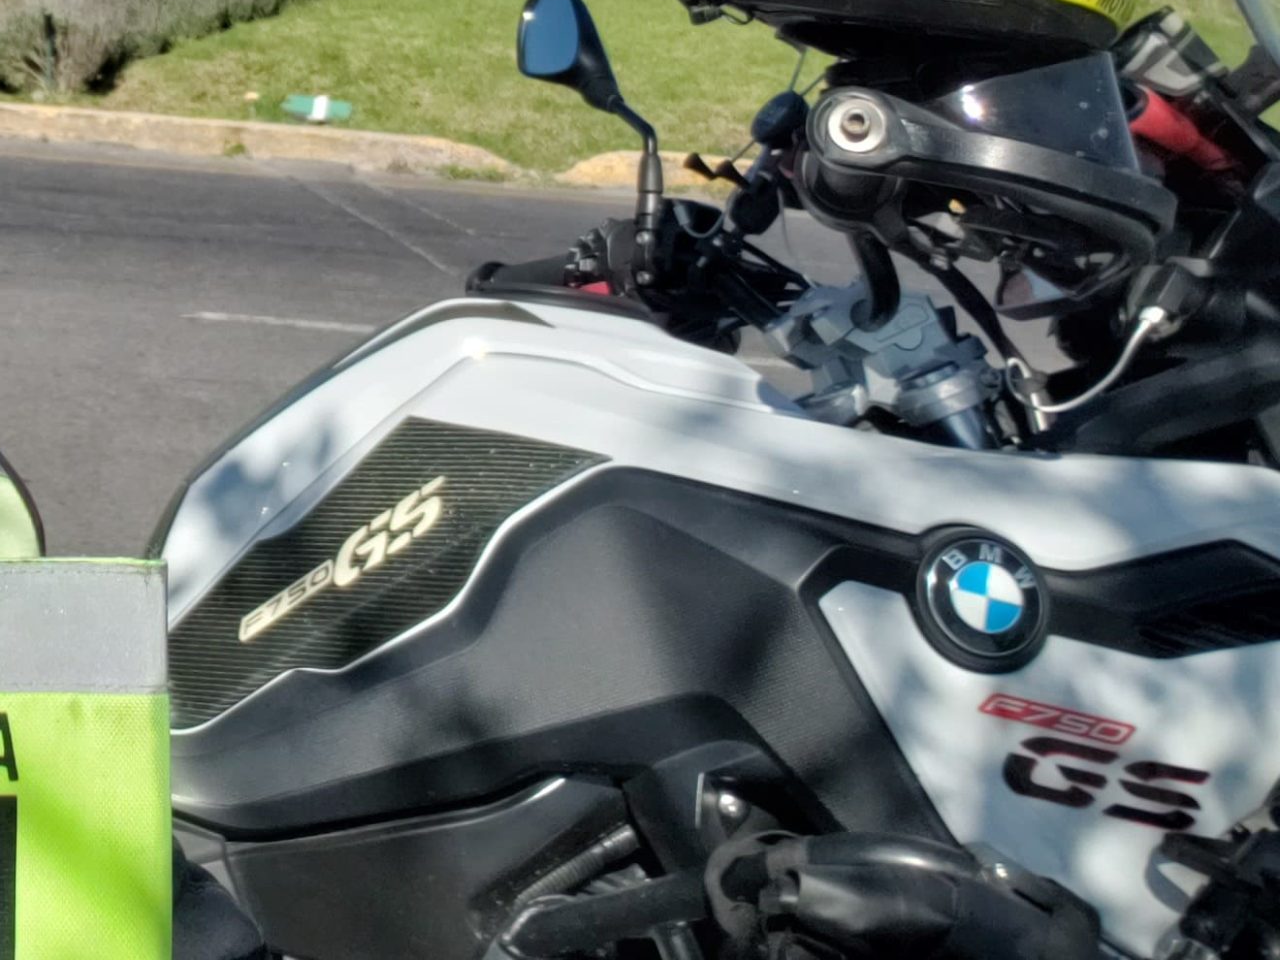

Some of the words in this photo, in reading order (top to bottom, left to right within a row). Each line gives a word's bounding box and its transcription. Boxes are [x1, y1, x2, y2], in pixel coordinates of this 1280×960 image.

[333, 475, 446, 586] GS
[941, 543, 1038, 589] BMW
[239, 559, 333, 641] F750
[981, 695, 1134, 744] F750
[1002, 737, 1210, 830] GS
